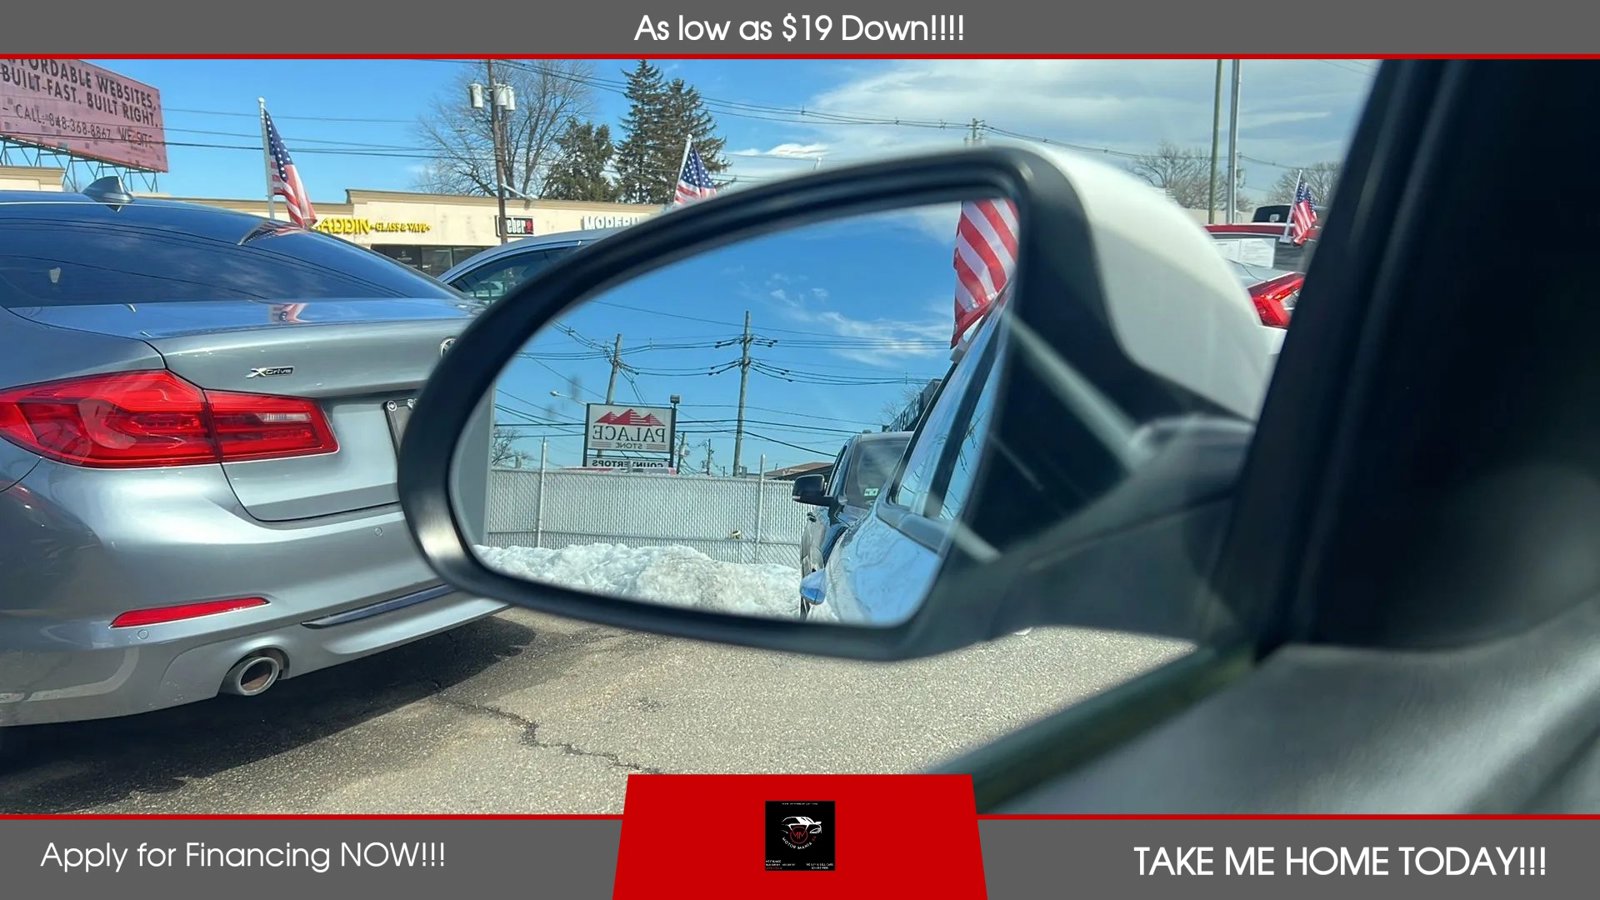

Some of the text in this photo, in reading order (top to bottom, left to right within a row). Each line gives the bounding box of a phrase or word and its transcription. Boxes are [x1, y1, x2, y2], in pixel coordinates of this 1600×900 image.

[7, 59, 92, 89] ORDABLE
[15, 104, 46, 125] CALL:
[87, 92, 118, 116] BUILT
[122, 102, 159, 128] RIGHT.
[316, 218, 370, 234] ADDIN
[501, 217, 526, 234] eber
